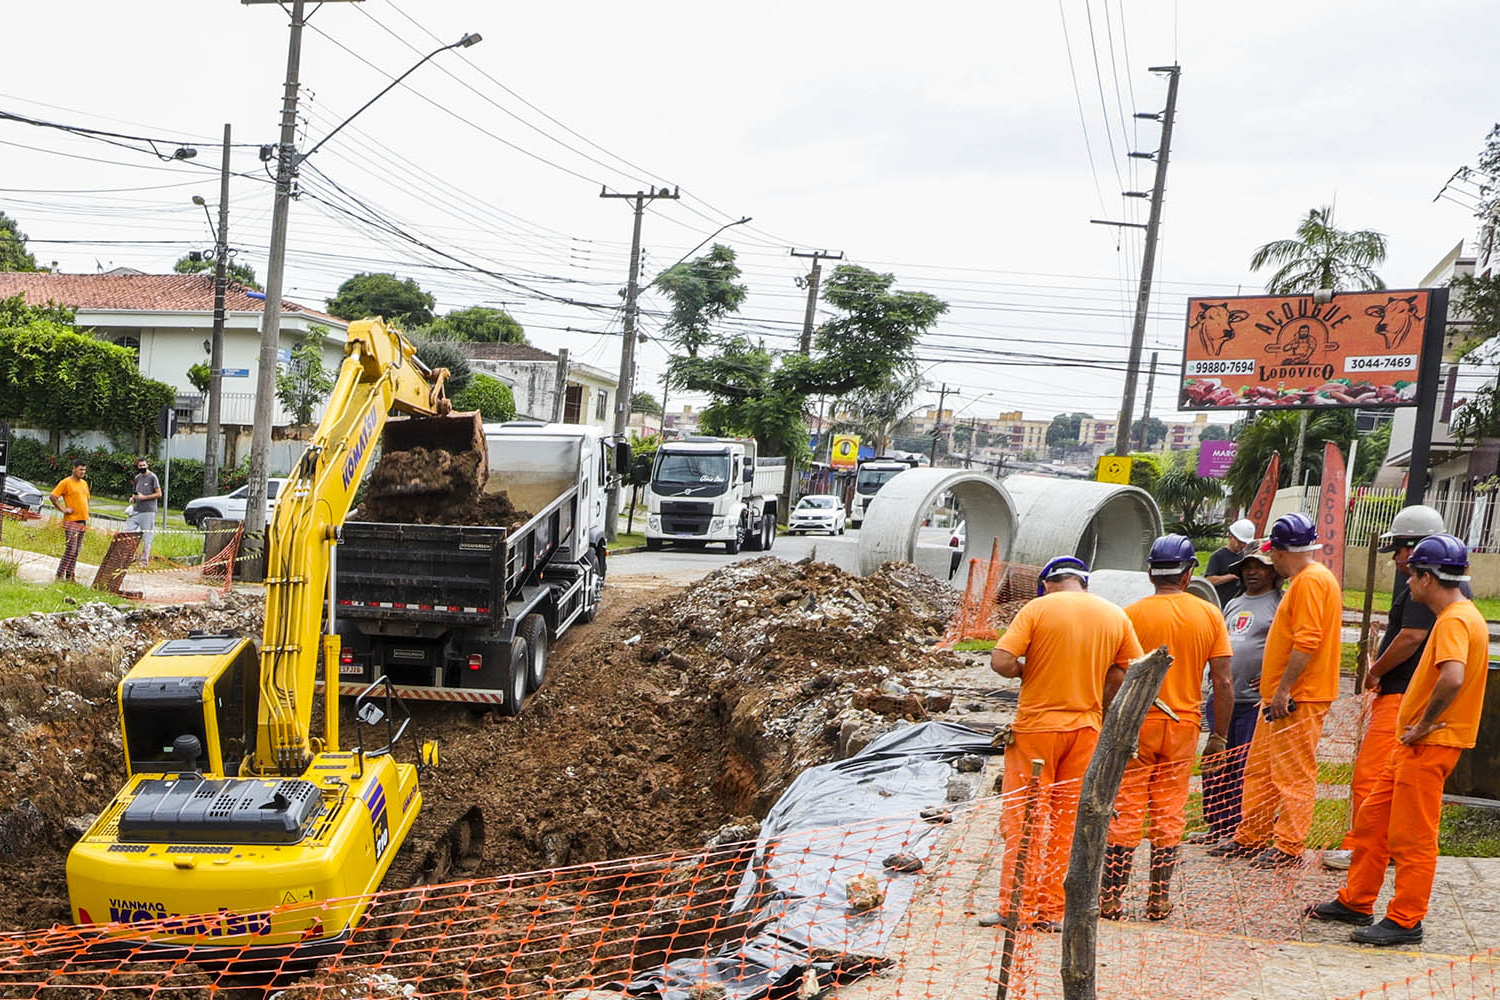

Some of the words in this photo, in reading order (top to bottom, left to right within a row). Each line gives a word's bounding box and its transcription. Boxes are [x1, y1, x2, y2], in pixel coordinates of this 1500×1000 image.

[1196, 361, 1254, 373] 99880-7694
[1351, 357, 1412, 369] 3044-7469
[109, 898, 166, 912] VIANMAQ
